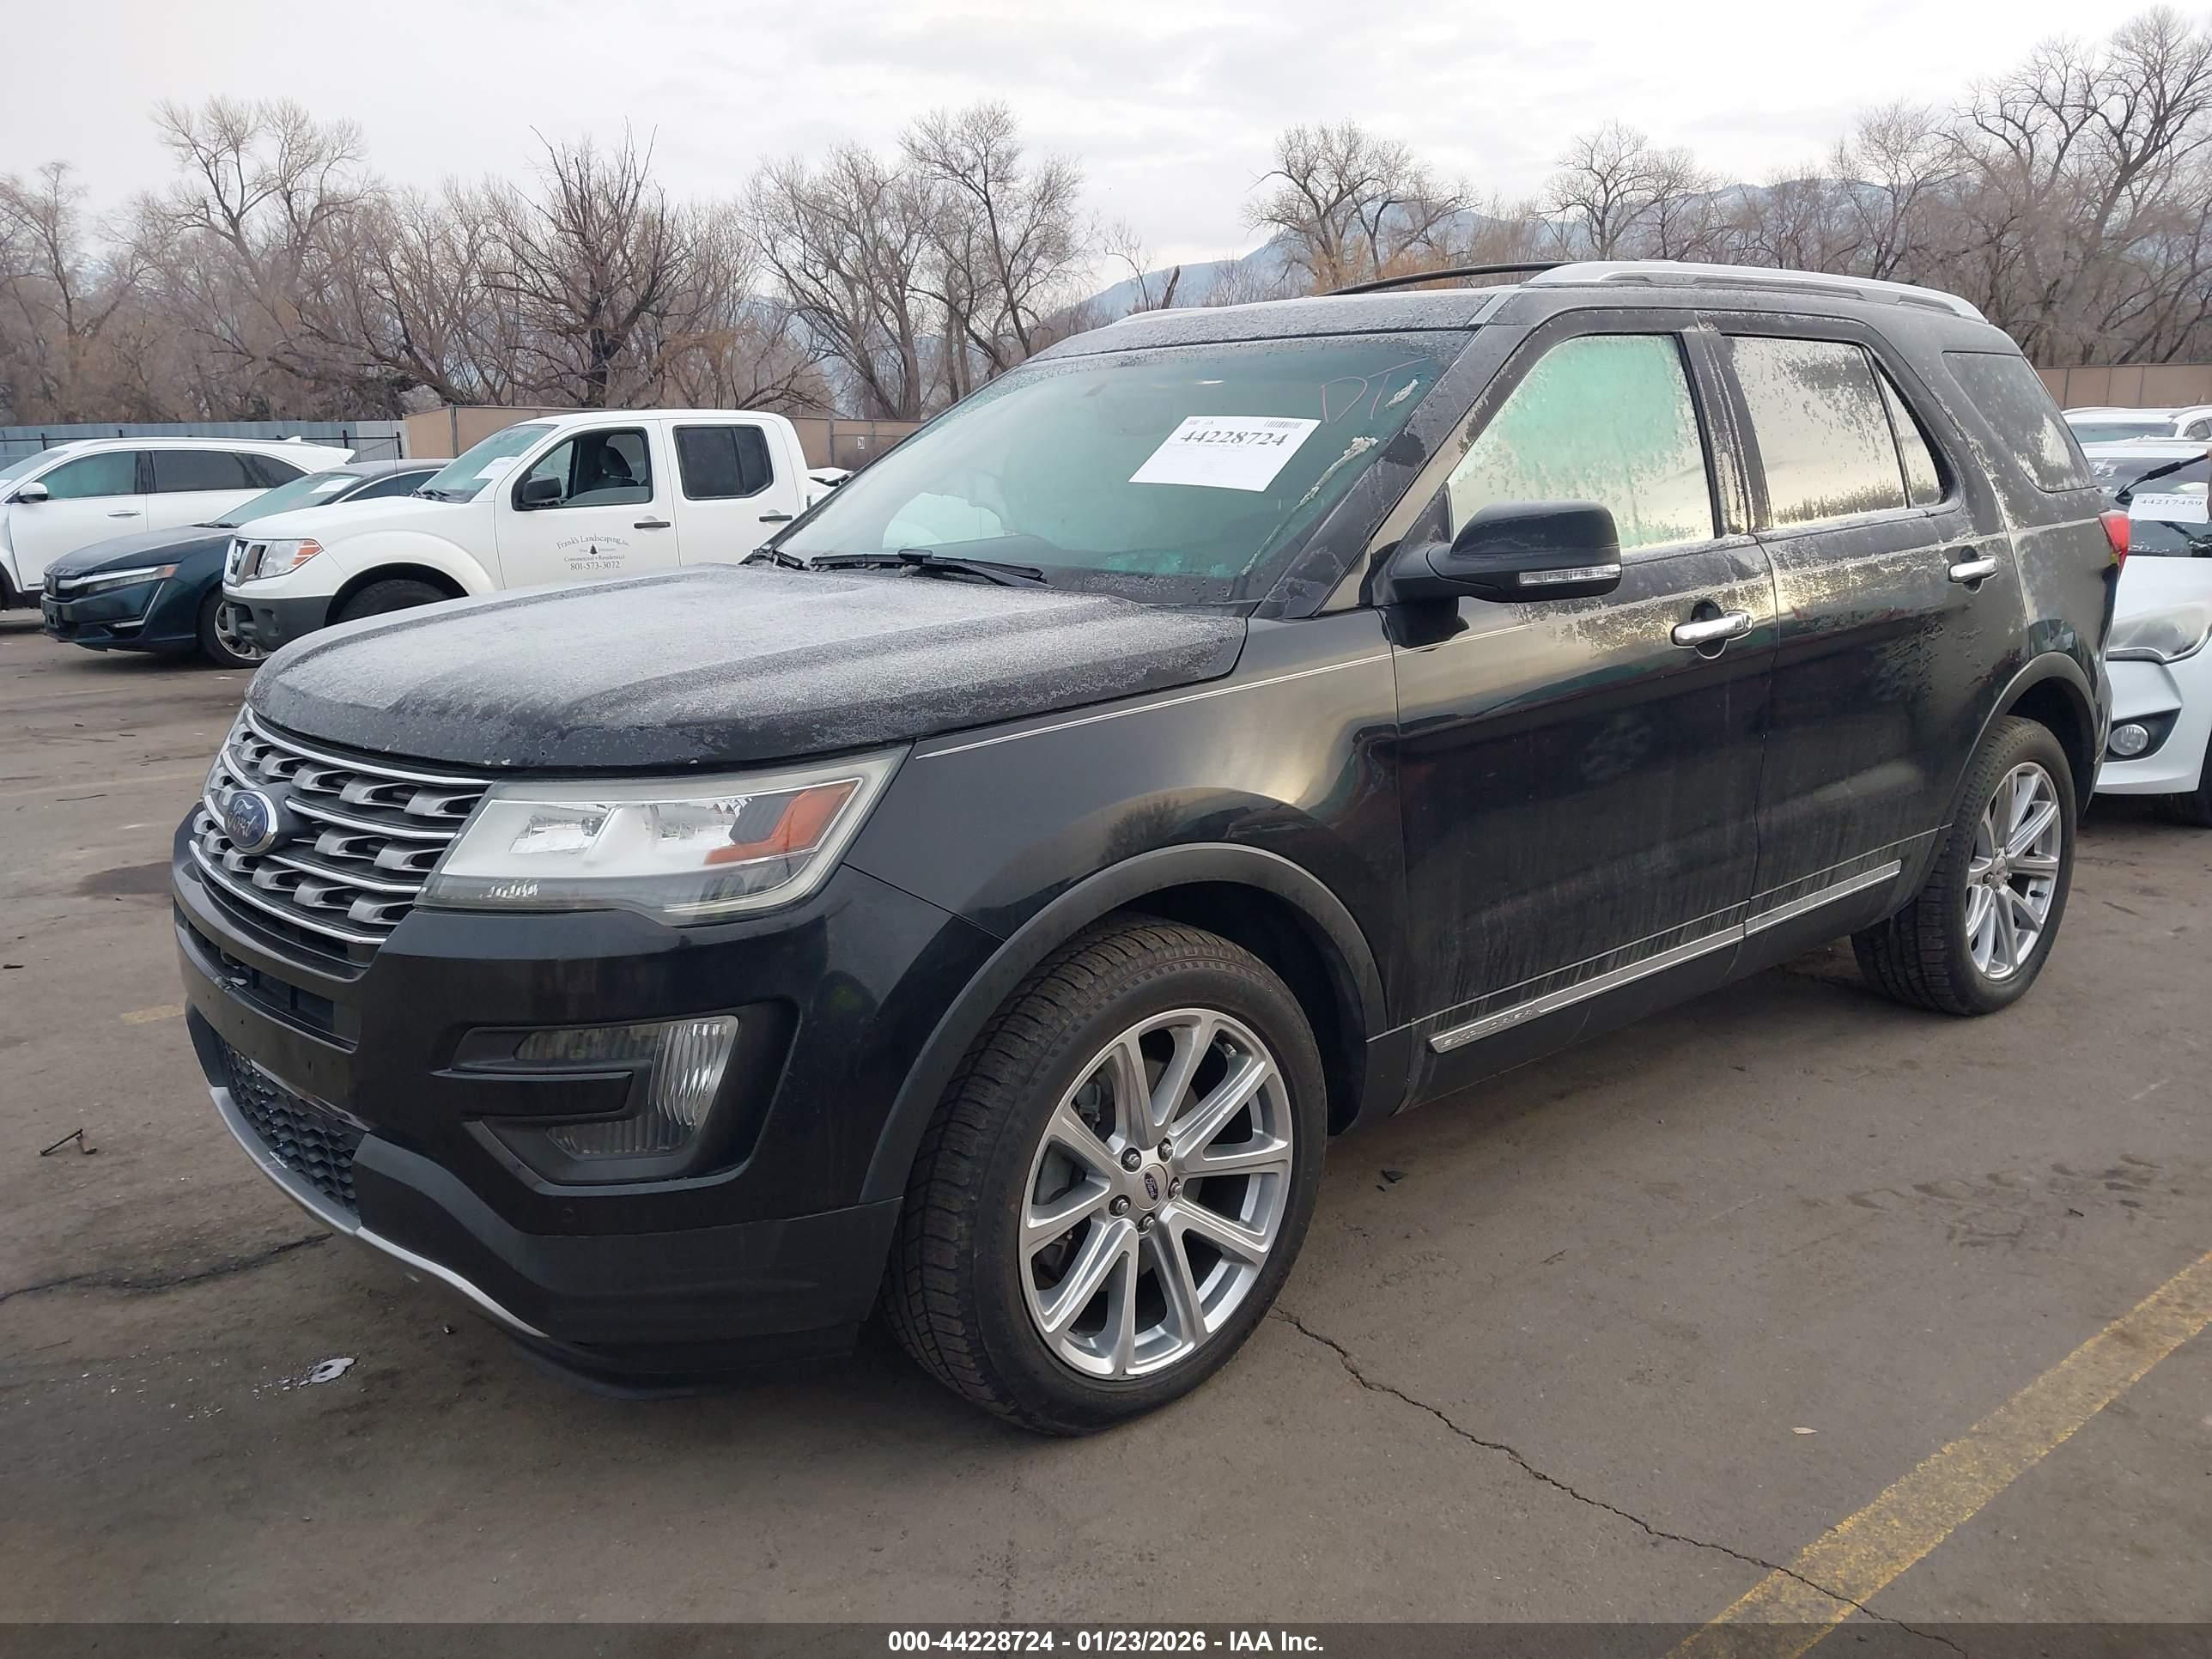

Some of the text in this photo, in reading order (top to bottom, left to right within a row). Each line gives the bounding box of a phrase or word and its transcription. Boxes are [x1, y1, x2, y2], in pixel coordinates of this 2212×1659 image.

[1181, 430, 1289, 446] 44228724
[570, 562, 620, 570] 801-573-3072
[228, 799, 257, 837] Ford
[1441, 1009, 1533, 1048] EXPLORER
[1146, 1177, 1158, 1196] Ford
